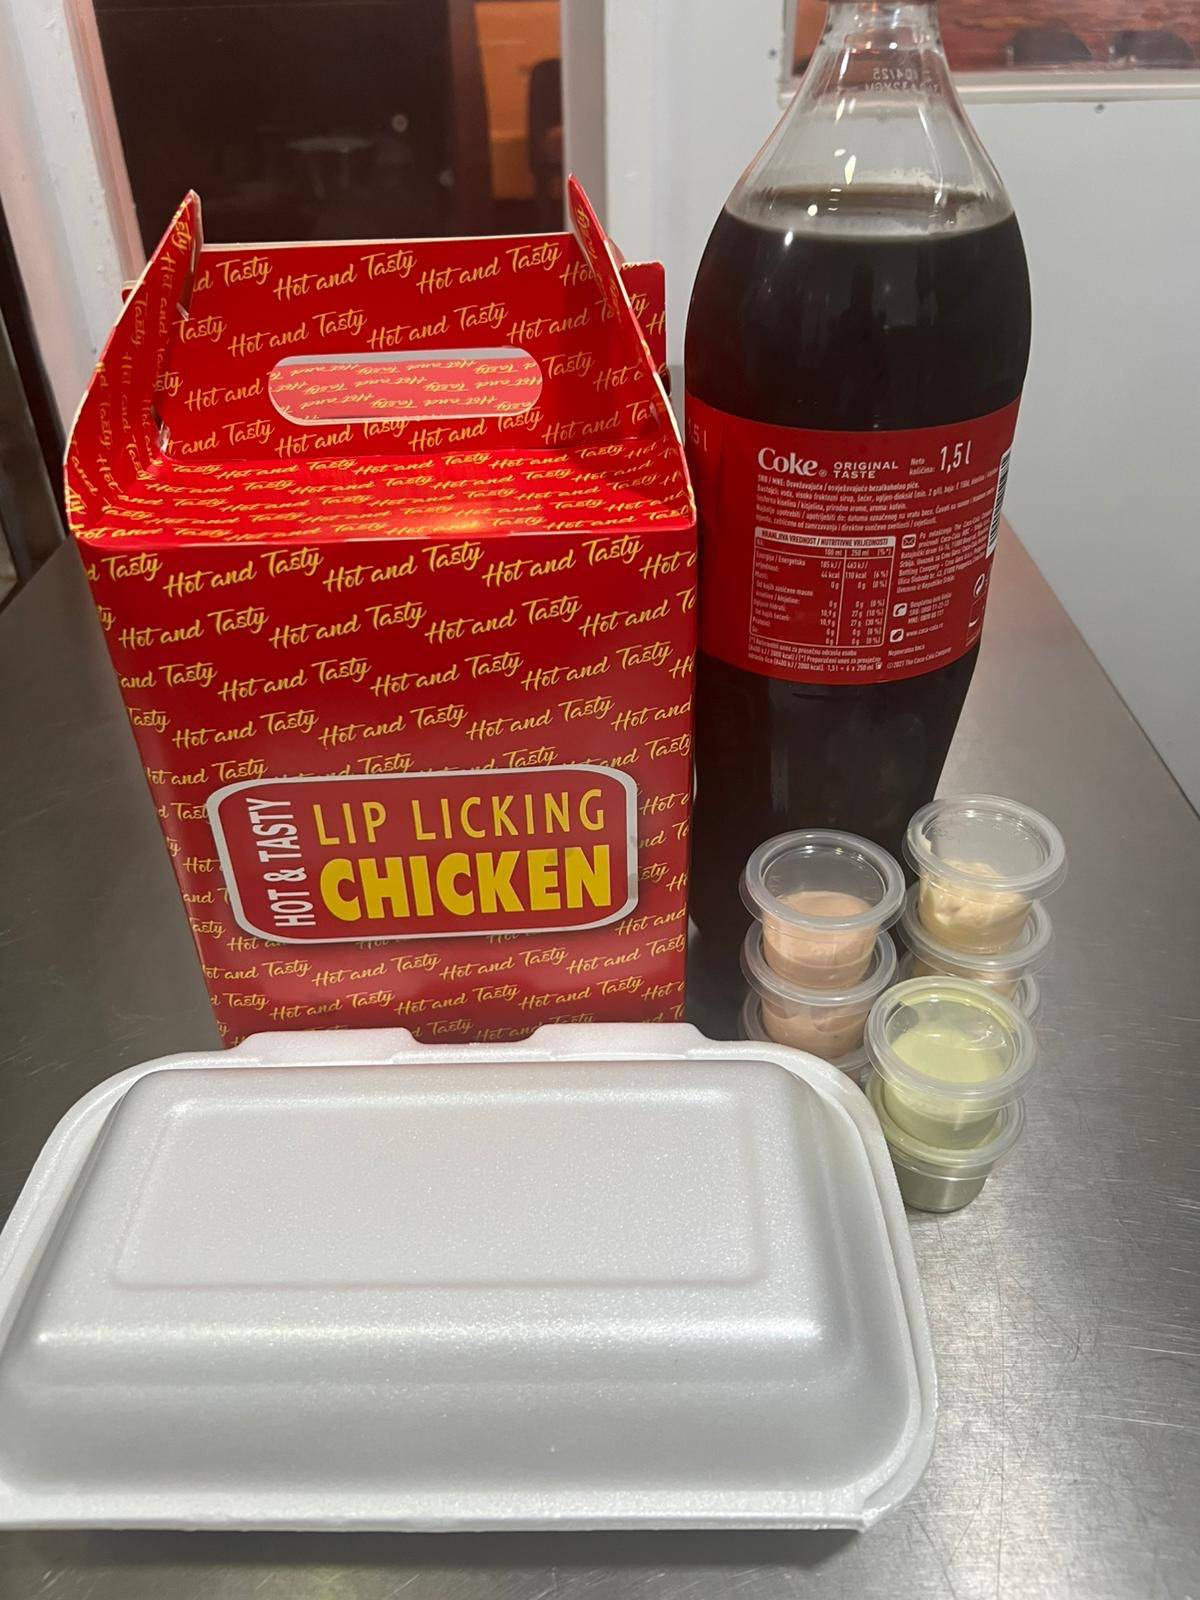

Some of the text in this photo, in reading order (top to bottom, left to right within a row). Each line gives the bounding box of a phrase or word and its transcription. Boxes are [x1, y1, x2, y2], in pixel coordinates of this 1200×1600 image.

[216, 242, 563, 300] Tasty Hot and Tasty Hot and Tasty
[172, 302, 590, 357] Tasty Hot and Tasty Hot and Tasty Hot and
[185, 352, 627, 412] Hot and Tasty Hot
[182, 432, 219, 456] and
[222, 419, 274, 444] Tasty
[275, 435, 318, 457] Hot
[314, 425, 353, 448] and
[409, 428, 451, 452] Hot
[449, 419, 487, 441] and
[497, 409, 544, 433] Tasty
[542, 424, 584, 444] Hot
[582, 411, 621, 435] and
[757, 447, 819, 477] Coke
[833, 460, 899, 471] ORIGINAL
[834, 470, 876, 480] TASTE
[102, 534, 692, 598] Tasty Hot and Tasty Hot and Tasty Hot and Tasty Hot
[118, 595, 670, 650] Hot and Tasty Hot and Tasty Hot and Tasty Hot and
[120, 641, 673, 702] and Tasty Hot and Tasty Hot and Tasty Hot and Tasty
[172, 729, 216, 749] Hot
[215, 721, 257, 744] and
[260, 709, 318, 734] Tasty
[318, 724, 366, 748] Hot
[363, 716, 406, 738] and
[410, 704, 468, 729] Tasty
[466, 718, 514, 742] Hot
[510, 710, 554, 733] and
[558, 695, 615, 722] Tasty
[611, 709, 657, 732] Hot
[654, 695, 691, 720] and
[171, 758, 269, 785] and Tasty
[357, 753, 415, 775] Tasty
[502, 746, 559, 768] Tasty
[313, 788, 605, 846] LIP LICKING
[639, 794, 676, 815] Hot
[183, 857, 219, 873] Hot
[246, 797, 316, 927] HOT & TASTY
[319, 843, 612, 922] CHICKEN
[183, 891, 215, 903] and
[615, 904, 686, 936] Hot and
[227, 937, 259, 951] Hot
[224, 966, 259, 979] and
[262, 959, 312, 977] Tasty
[312, 969, 352, 987] Hot
[350, 963, 387, 981] and
[390, 953, 441, 971] Tasty
[439, 964, 479, 981] Hot
[477, 957, 515, 975] and
[519, 947, 569, 966] Tasty
[566, 958, 607, 975] Hot
[603, 948, 641, 966] and
[223, 975, 677, 1021] Tasty Hot and Tasty Hot and Tasty Hot and Tasty Hot
